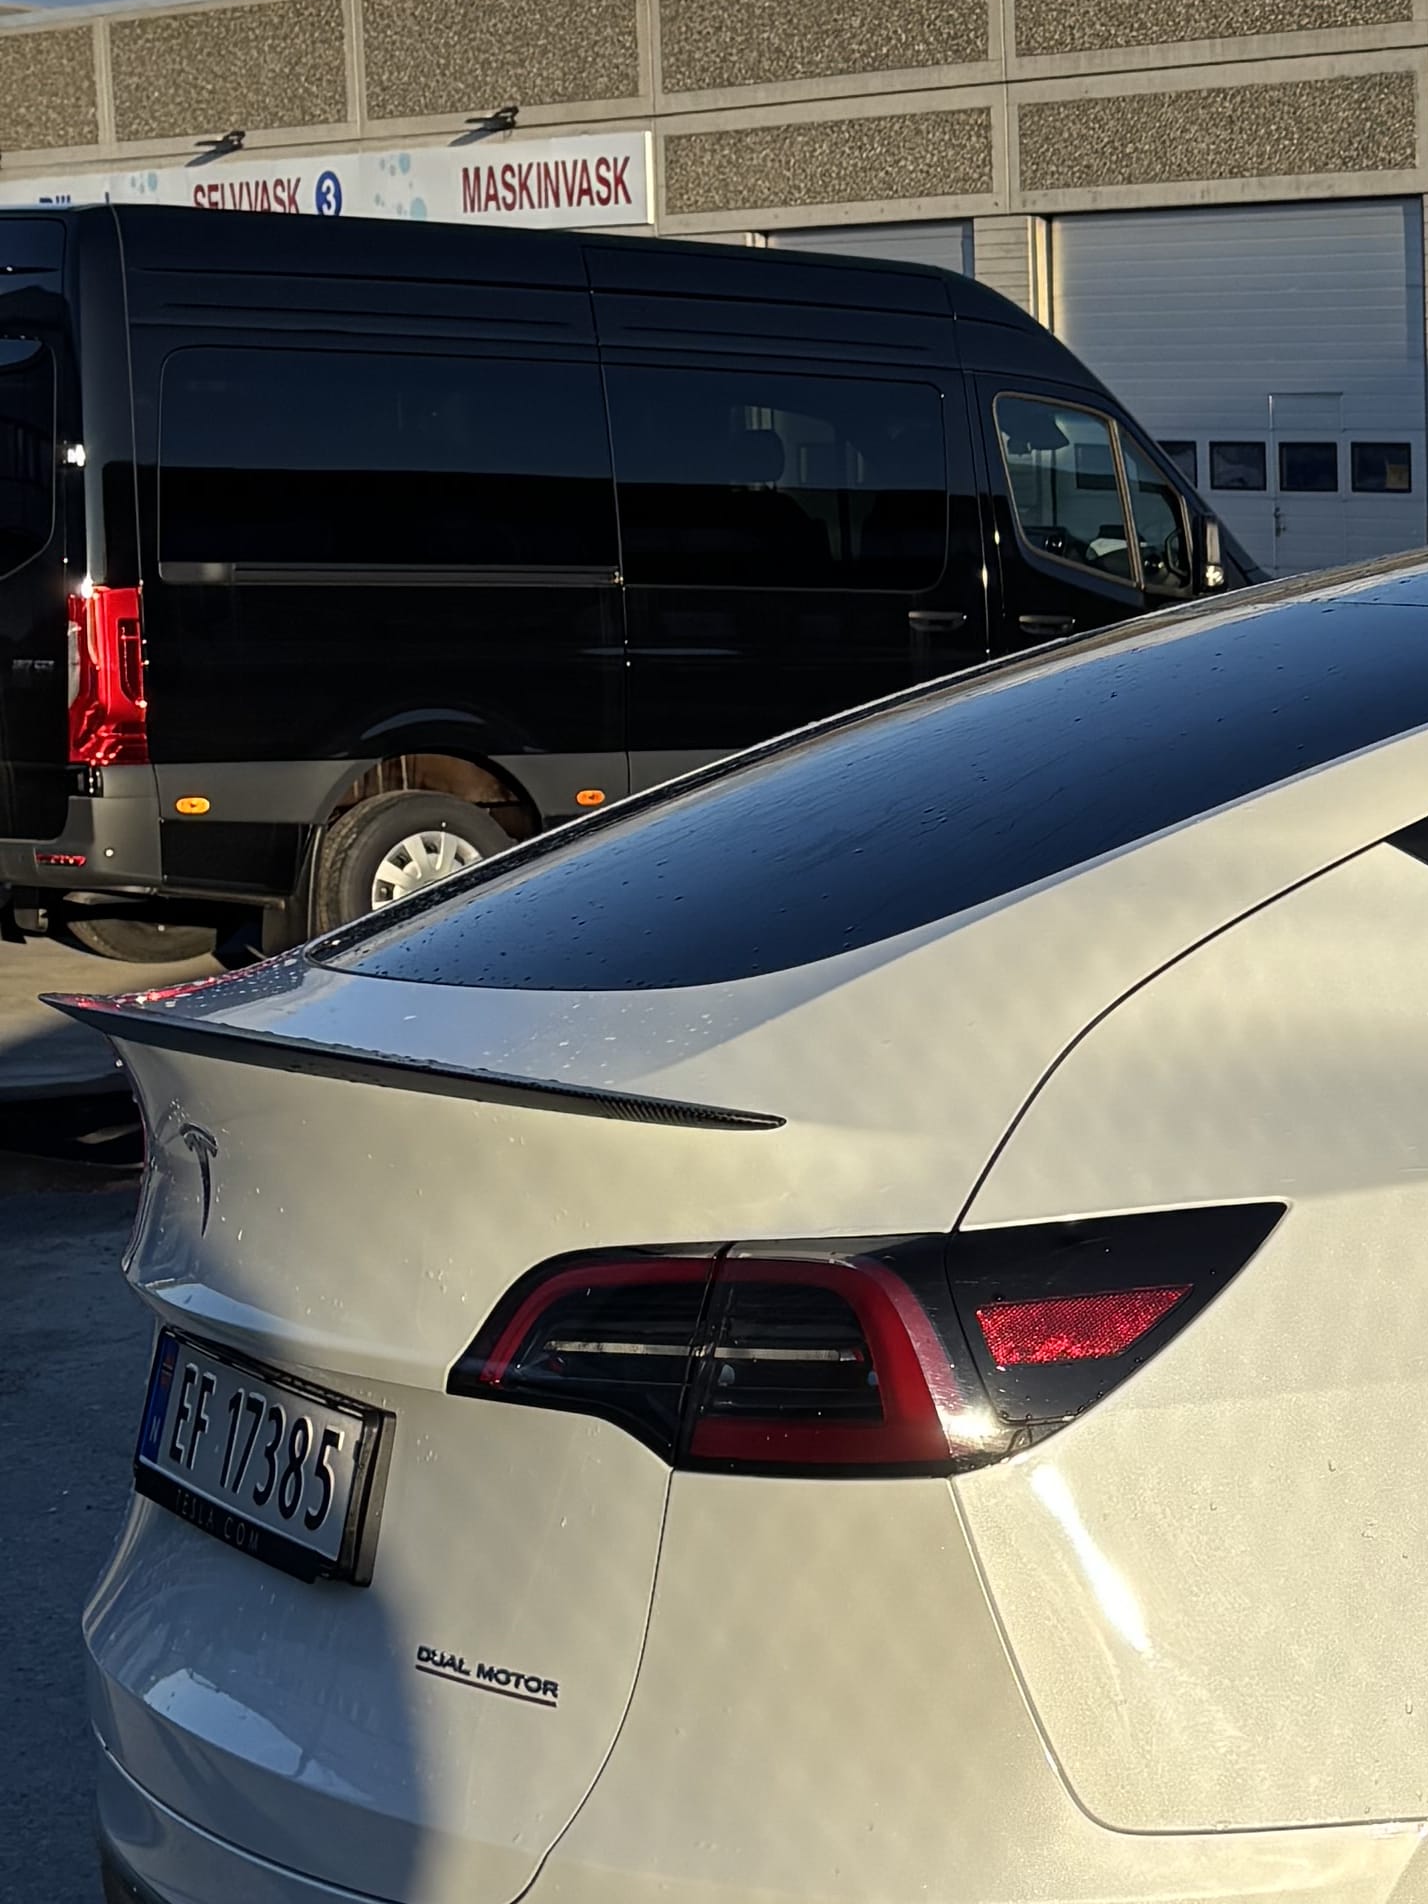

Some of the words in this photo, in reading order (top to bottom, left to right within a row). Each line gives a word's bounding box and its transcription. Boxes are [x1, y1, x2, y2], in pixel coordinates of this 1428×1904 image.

[462, 156, 632, 213] MASKINVASK
[168, 1362, 217, 1471] EF
[219, 1387, 346, 1532] 17385
[416, 1645, 471, 1677] DUAL
[476, 1662, 559, 1698] MOTOR
